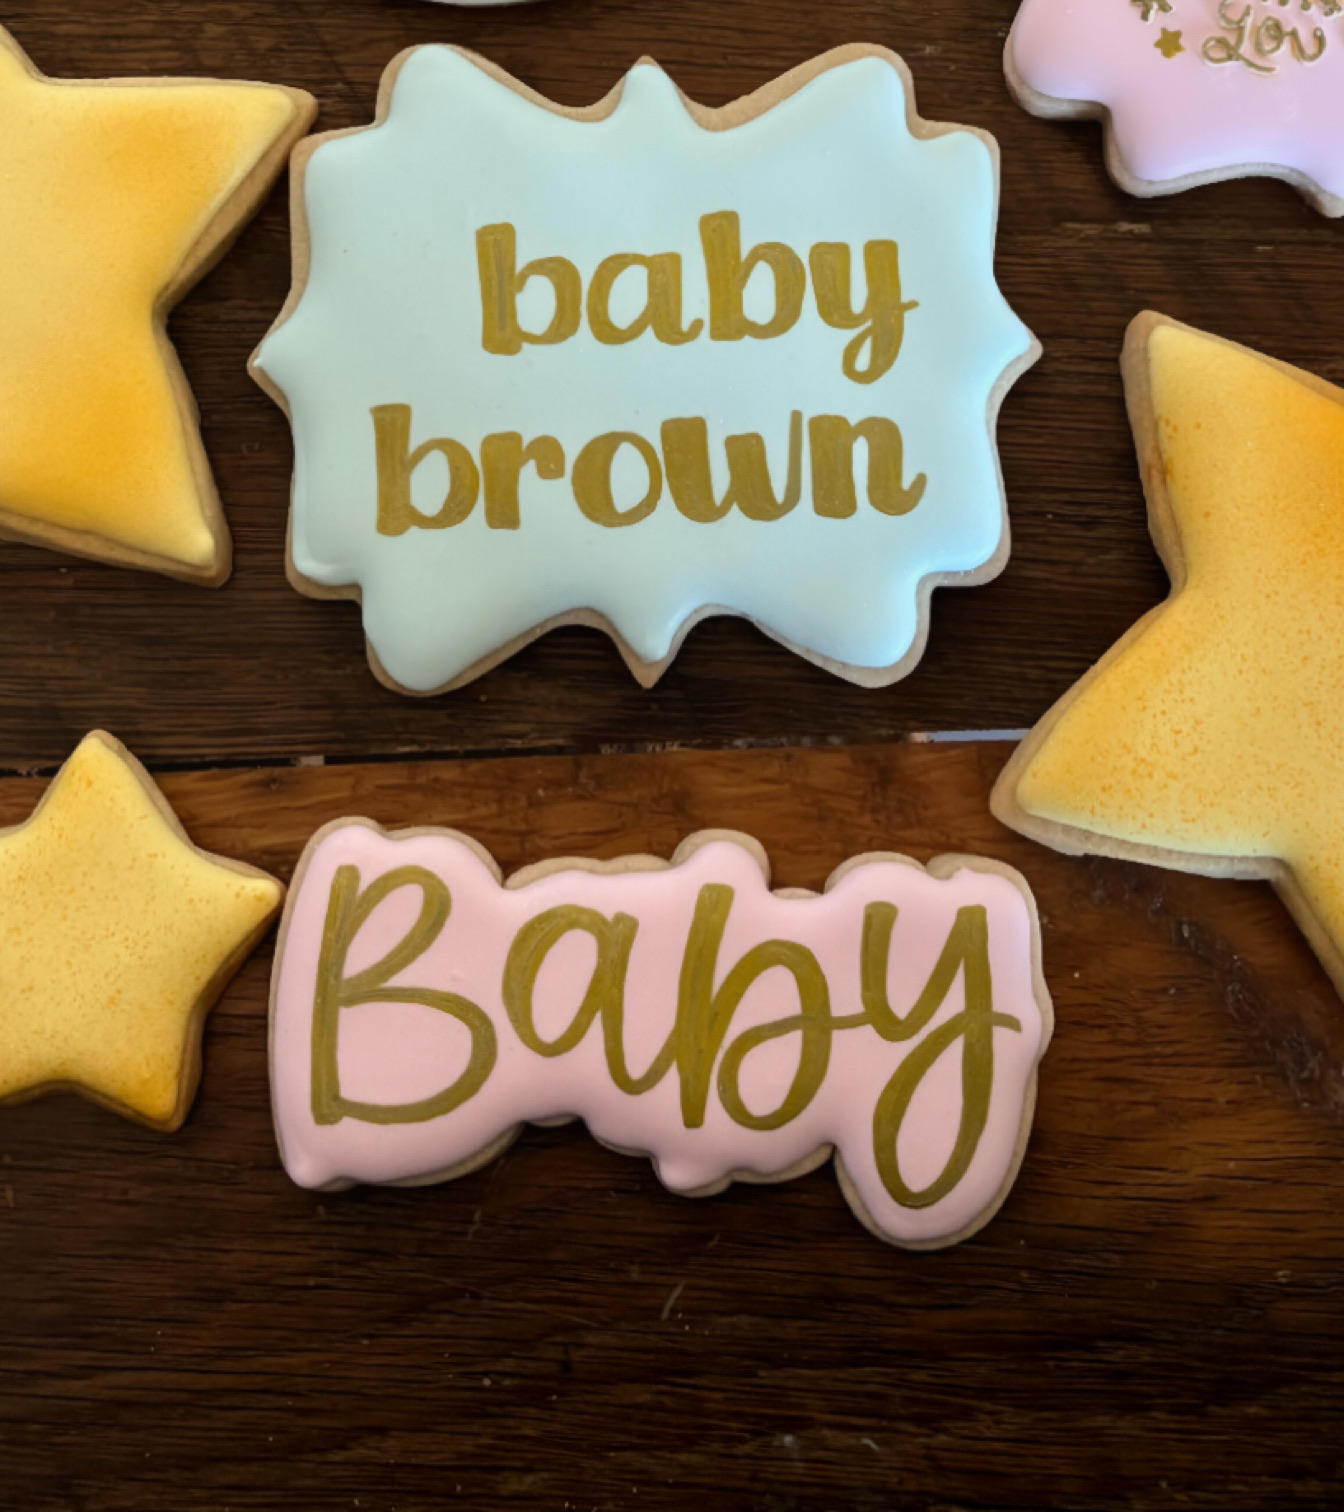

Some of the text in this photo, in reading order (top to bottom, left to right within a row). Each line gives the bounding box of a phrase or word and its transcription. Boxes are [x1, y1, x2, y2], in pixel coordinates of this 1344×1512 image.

[475, 209, 920, 385] baby
[368, 402, 929, 538] brown
[309, 863, 1023, 1210] Baby
